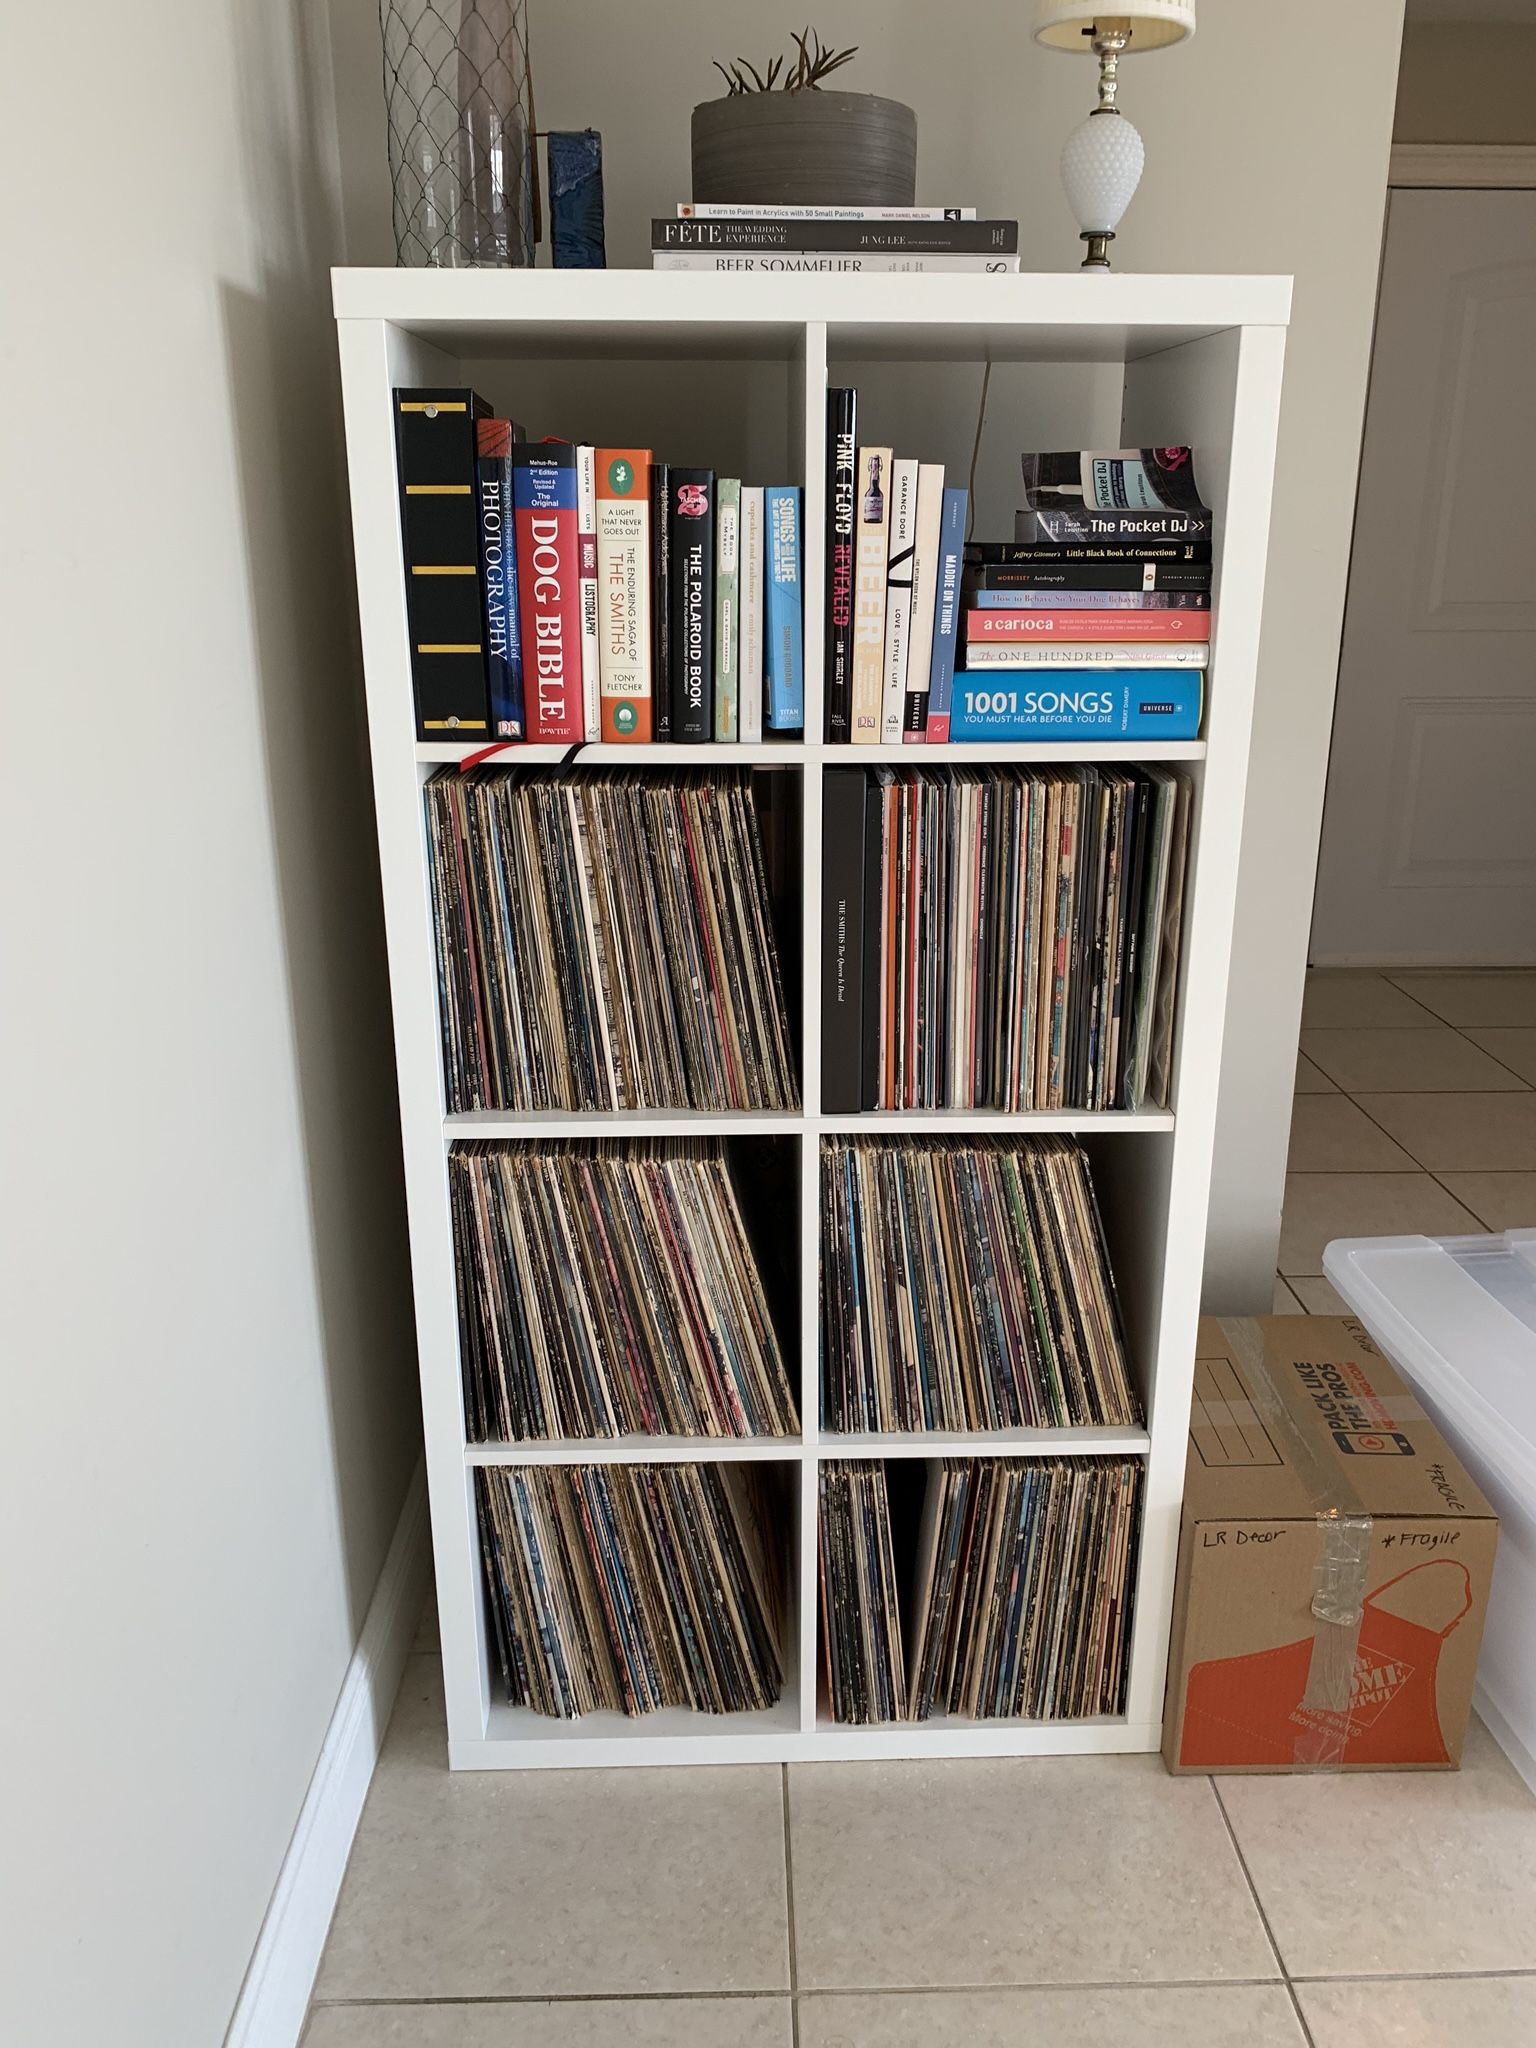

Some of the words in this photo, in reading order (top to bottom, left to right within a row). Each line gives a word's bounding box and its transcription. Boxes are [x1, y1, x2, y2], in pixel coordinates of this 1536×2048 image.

[708, 207, 728, 215] Learn
[737, 208, 754, 216] Paint
[755, 208, 762, 216] in
[763, 208, 788, 217] Acrylics
[790, 209, 803, 217] with
[805, 209, 814, 217] 50
[834, 210, 864, 218] Paintings
[664, 220, 722, 243] FÊTE
[726, 225, 743, 233] THE
[744, 225, 788, 233] WEDDING
[726, 234, 787, 243] EXPERIENCE
[860, 235, 885, 244] JUNG
[887, 235, 906, 245] LEE
[836, 433, 853, 474] PINK
[538, 468, 559, 476] Edition
[1097, 462, 1107, 474] DJ
[537, 492, 551, 500] The
[899, 475, 908, 514] GARANCE
[1099, 476, 1110, 505] Pocket
[531, 499, 559, 508] Original
[835, 483, 853, 535] FLOYD
[748, 501, 758, 540] cupcakes
[779, 497, 796, 543] SONGS
[1090, 519, 1116, 533] The
[1119, 519, 1167, 533] Pocket
[1170, 519, 1188, 533] DJ
[531, 516, 561, 605] DOG
[583, 543, 594, 569] MUSIC
[627, 548, 635, 564] THE
[690, 544, 702, 576] THE
[749, 543, 757, 560] and
[1013, 551, 1033, 559] Jeffrey
[1066, 549, 1084, 557] Little
[1086, 549, 1105, 557] Black
[1106, 549, 1124, 557] Book
[1126, 548, 1135, 557] of
[1135, 548, 1177, 557] Connections
[482, 480, 507, 660] PHOTOGRAPHY
[506, 566, 517, 584] the
[609, 553, 625, 585] THE
[780, 556, 797, 583] LIFE
[943, 554, 957, 588] MADDIE
[1033, 575, 1066, 583] Autobiography
[627, 567, 636, 617] ENDURING
[749, 562, 757, 603] cashmere
[833, 544, 851, 627] REVEALED
[856, 535, 886, 644] BEER
[942, 590, 954, 602] ON
[1068, 595, 1088, 603] Your
[584, 584, 596, 637] LISTOGRAPHY
[690, 581, 702, 661] POLAROID
[940, 603, 953, 635] THINGS
[508, 609, 519, 646] manual
[609, 592, 626, 656] SMITHS
[628, 620, 637, 646] SAGA
[983, 619, 993, 631] a
[995, 619, 1054, 631] carioca
[511, 647, 521, 659] of
[628, 650, 637, 662] OF
[836, 641, 844, 653] IAN
[892, 639, 900, 663] STYLE
[998, 651, 1031, 662] ONE
[1038, 651, 1114, 662] HUNDRED
[535, 613, 566, 721] BIBLE
[784, 653, 793, 688] GODDARD
[607, 683, 643, 691] FLETCHER
[690, 666, 702, 708] BOOK
[890, 672, 898, 689] LIFE
[779, 708, 799, 716] TITAN
[911, 693, 921, 730] UNIVERSE
[964, 691, 1017, 714] 1001
[1023, 691, 1113, 714] SONGS
[499, 721, 519, 734] DK
[964, 715, 984, 723] YOU
[986, 715, 1011, 723] MUST
[1013, 715, 1038, 723] HEAR
[1040, 715, 1073, 723] BEFORE
[1076, 715, 1096, 723] YOU
[1098, 715, 1113, 723] DIE
[838, 899, 846, 914] THE
[838, 916, 846, 944] SMITHS
[838, 944, 846, 956] The
[837, 957, 845, 977] Queen
[837, 985, 845, 1002] Dead
[1293, 1362, 1325, 1389] LIKE
[1316, 1363, 1353, 1399] PROS
[1311, 1394, 1349, 1429] PACK
[1341, 1403, 1371, 1430] THE
[1203, 1531, 1226, 1547] LR
[1236, 1530, 1286, 1545] Decor
[1400, 1530, 1461, 1550] Fragile
